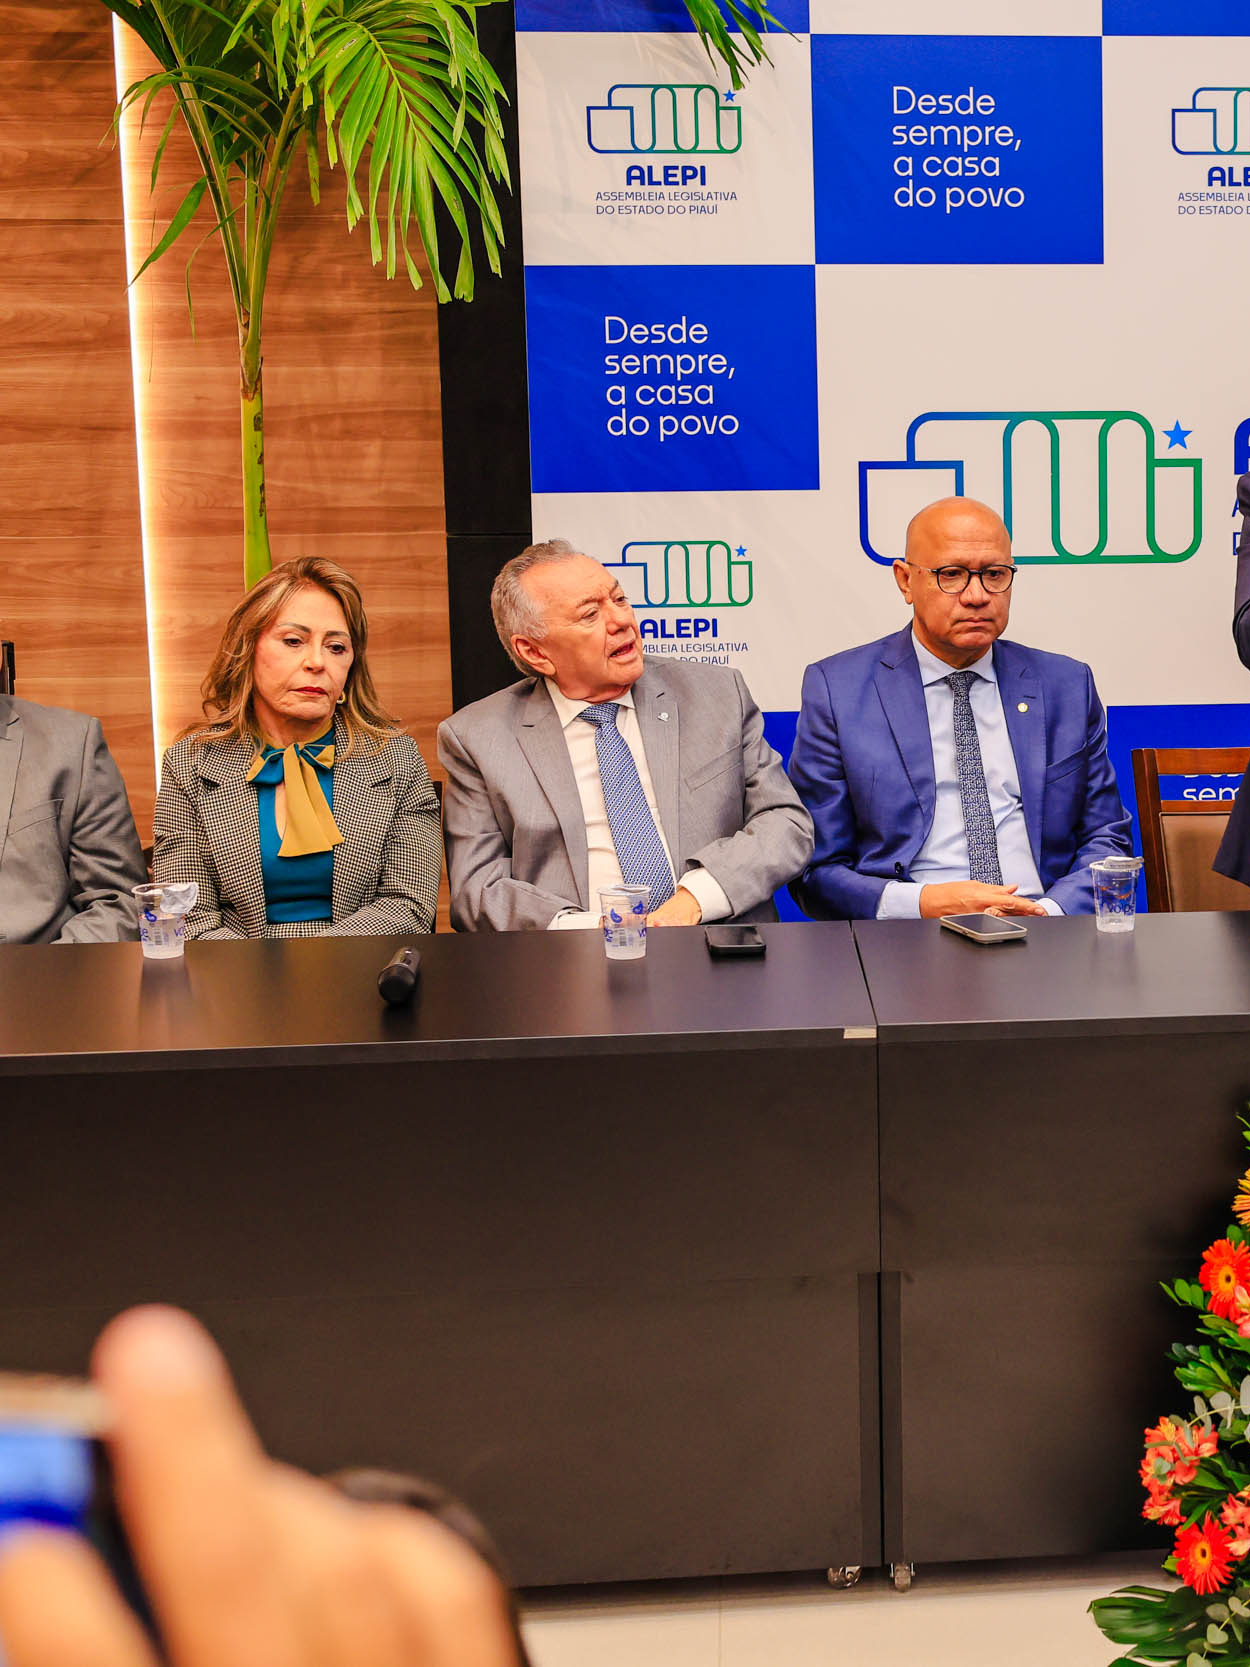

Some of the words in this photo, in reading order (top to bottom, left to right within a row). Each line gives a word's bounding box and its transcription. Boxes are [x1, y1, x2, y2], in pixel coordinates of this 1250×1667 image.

[893, 86, 996, 115] Desde
[892, 125, 1022, 153] sempre,
[625, 164, 707, 187] ALEPI
[893, 156, 913, 177] a
[922, 156, 1000, 177] casa
[595, 191, 666, 202] ASSEMBLEIA
[668, 191, 738, 202] LEGISLATIVA
[893, 179, 937, 207] do
[946, 187, 1025, 214] povo
[1177, 192, 1245, 202] ASSEMBLEIA
[595, 204, 616, 215] DO
[617, 204, 665, 215] ESTADO
[667, 204, 687, 215] DO
[688, 203, 719, 215] PIAUÍ
[1177, 205, 1197, 215] DO
[1199, 205, 1244, 215] ESTADO
[604, 315, 709, 344] Desde
[604, 353, 736, 382] sempre,
[606, 384, 626, 406] a
[635, 384, 714, 406] casa
[607, 407, 650, 437] do
[659, 414, 740, 443] povo
[639, 617, 718, 639] ALEPI
[642, 643, 678, 653] MBLEIA
[680, 642, 749, 653] LEGISLATIVA
